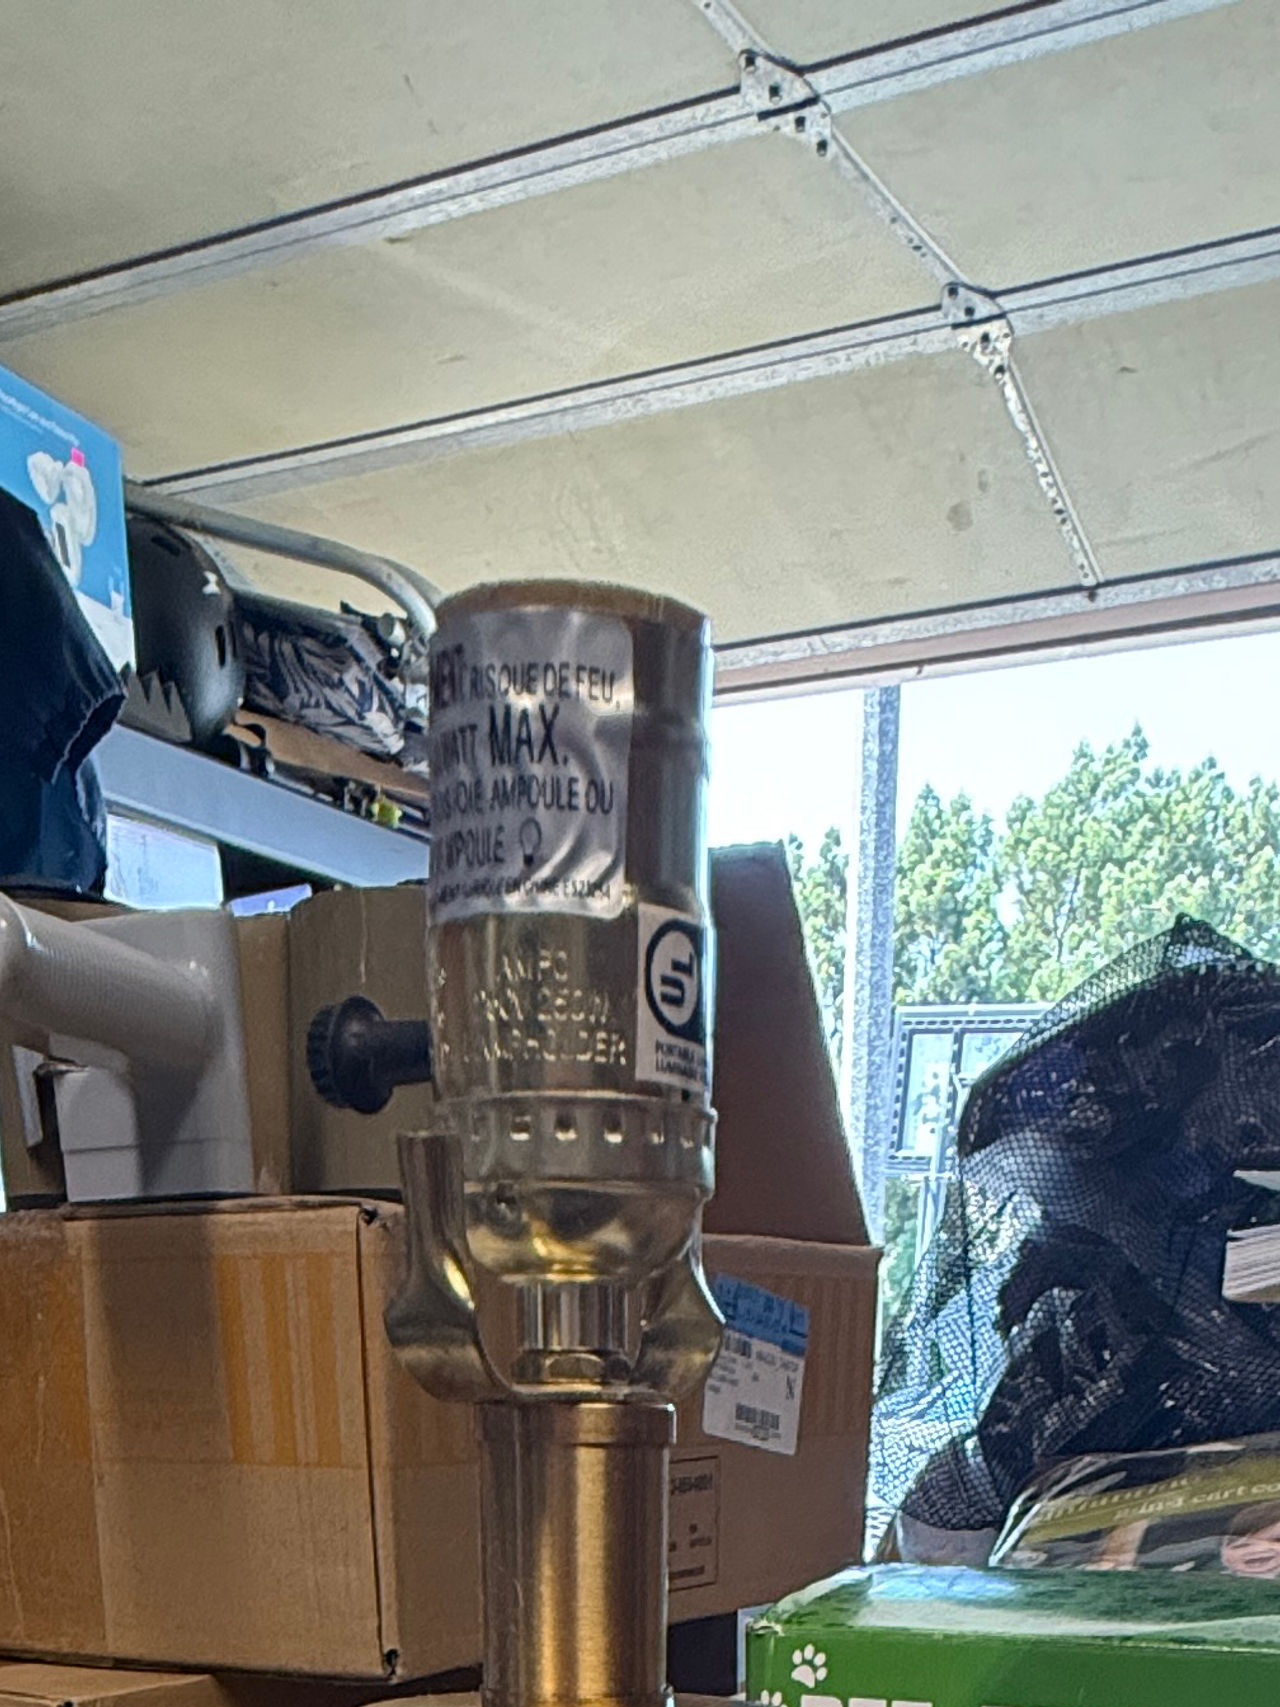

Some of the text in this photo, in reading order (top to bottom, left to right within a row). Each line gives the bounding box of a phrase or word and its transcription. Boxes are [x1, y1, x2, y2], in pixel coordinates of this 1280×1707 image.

[543, 661, 571, 698] DE
[489, 703, 569, 767] MAX.
[491, 774, 580, 812] AMPOULE
[585, 779, 614, 815] OU
[659, 951, 696, 1009] UL
